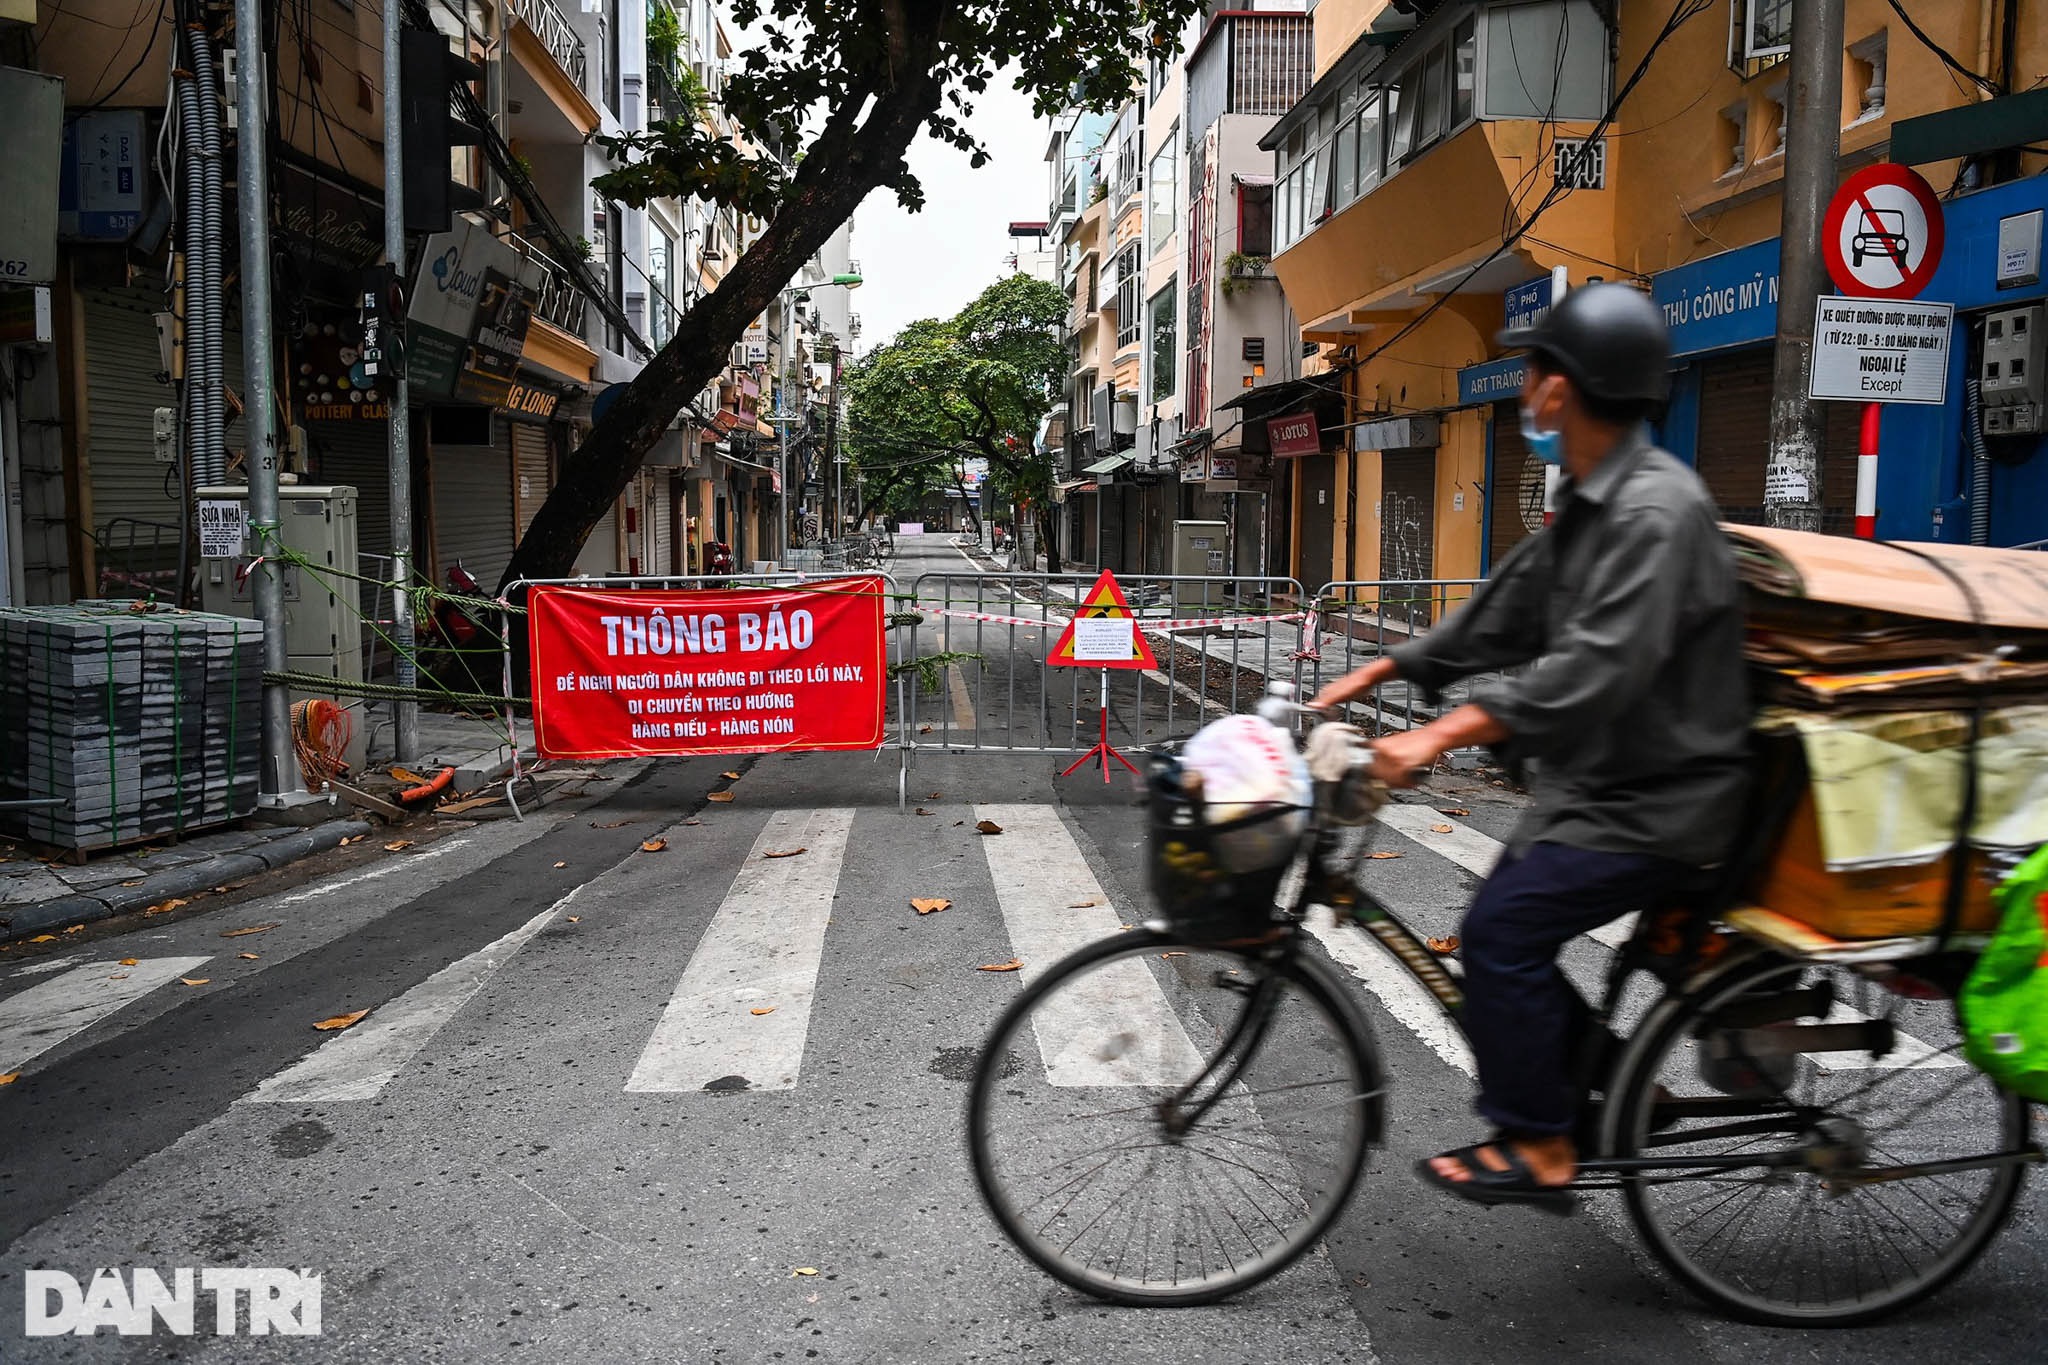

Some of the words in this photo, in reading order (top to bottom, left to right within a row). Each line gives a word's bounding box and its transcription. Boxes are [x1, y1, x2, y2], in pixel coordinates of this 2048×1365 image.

[437, 246, 482, 298] Cloud
[1521, 286, 1538, 306] PHỐ
[1663, 288, 1689, 327] THỦ
[1693, 285, 1735, 321] CÔNG
[1739, 271, 1764, 311] MỸ
[1509, 311, 1530, 329] HÀNG
[1822, 308, 1833, 322] XE
[1835, 306, 1855, 323] QUÉT
[1857, 307, 1883, 325] ĐƯỜNG
[1885, 311, 1906, 328] ĐƯỢC
[1907, 313, 1927, 329] HOẠT
[1927, 312, 1947, 330] ĐỘNG
[744, 334, 766, 343] HOTEL
[1830, 328, 1842, 345] TỪ
[1897, 332, 1918, 348] HÀNG
[1918, 334, 1939, 350] NGÀY
[1859, 355, 1892, 375] NGOẠI
[1894, 353, 1907, 376] LỆ
[1471, 375, 1488, 396] ART
[1490, 368, 1524, 391] TRÀNG
[1861, 376, 1903, 395] Except
[305, 404, 353, 421] POTTERY
[521, 388, 557, 417] LONG
[1279, 422, 1309, 441] LOTUS
[201, 502, 219, 523] SỬA
[221, 504, 241, 523] NHÀ
[218, 544, 229, 555] 721
[600, 607, 727, 656] THÔNG
[738, 603, 814, 652] BÁO
[556, 671, 575, 691] ĐỀ
[579, 675, 613, 693] NGHỊ
[616, 671, 660, 690] NGƯỜI
[664, 670, 693, 689] DÂN
[697, 669, 746, 688] KHÔNG
[749, 671, 764, 686] ĐI
[768, 668, 803, 684] THEO
[807, 662, 829, 683] LỐI
[833, 663, 863, 683] NÀY,
[646, 692, 702, 714] CHUYỂN
[706, 696, 741, 712] THEO
[745, 691, 794, 710] HƯỚNG
[632, 721, 670, 738] HÀNG
[674, 717, 706, 737] ĐIẾU
[720, 717, 759, 736] HÀNG
[763, 715, 794, 734] NÓN
